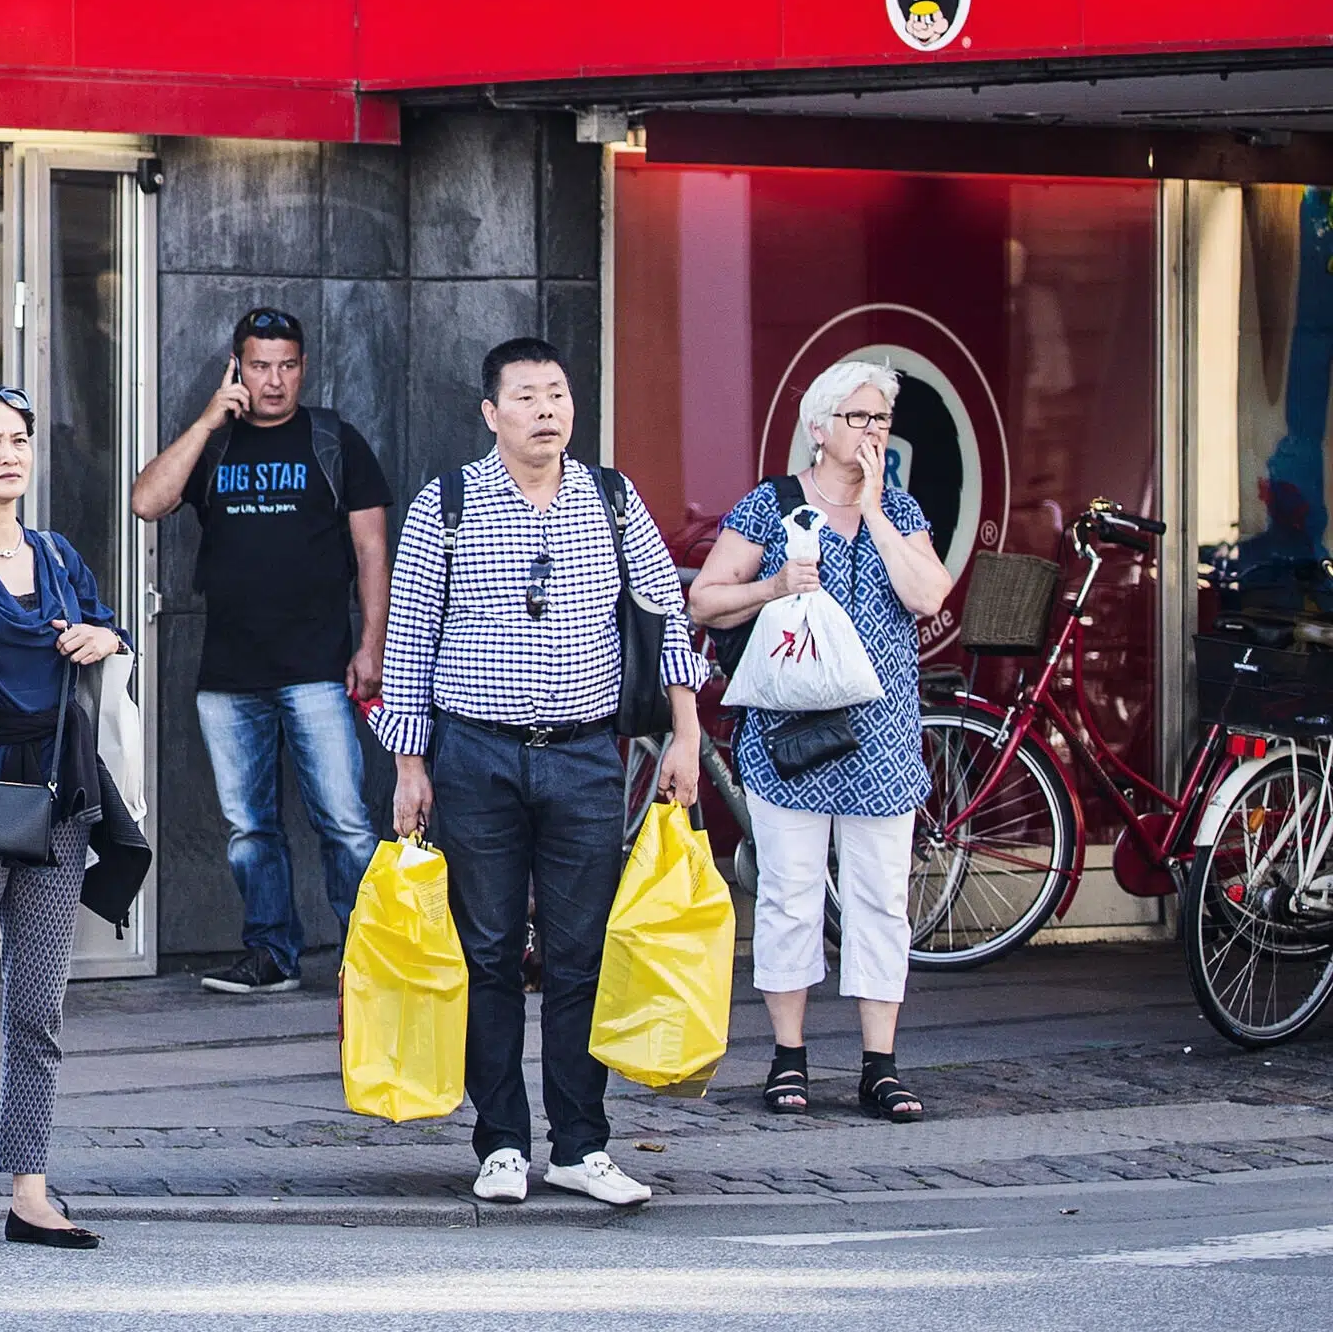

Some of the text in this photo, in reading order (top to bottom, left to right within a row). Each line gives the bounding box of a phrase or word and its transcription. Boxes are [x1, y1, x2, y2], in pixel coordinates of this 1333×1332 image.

[217, 462, 307, 493] BIG STAR
[883, 448, 902, 487] R
